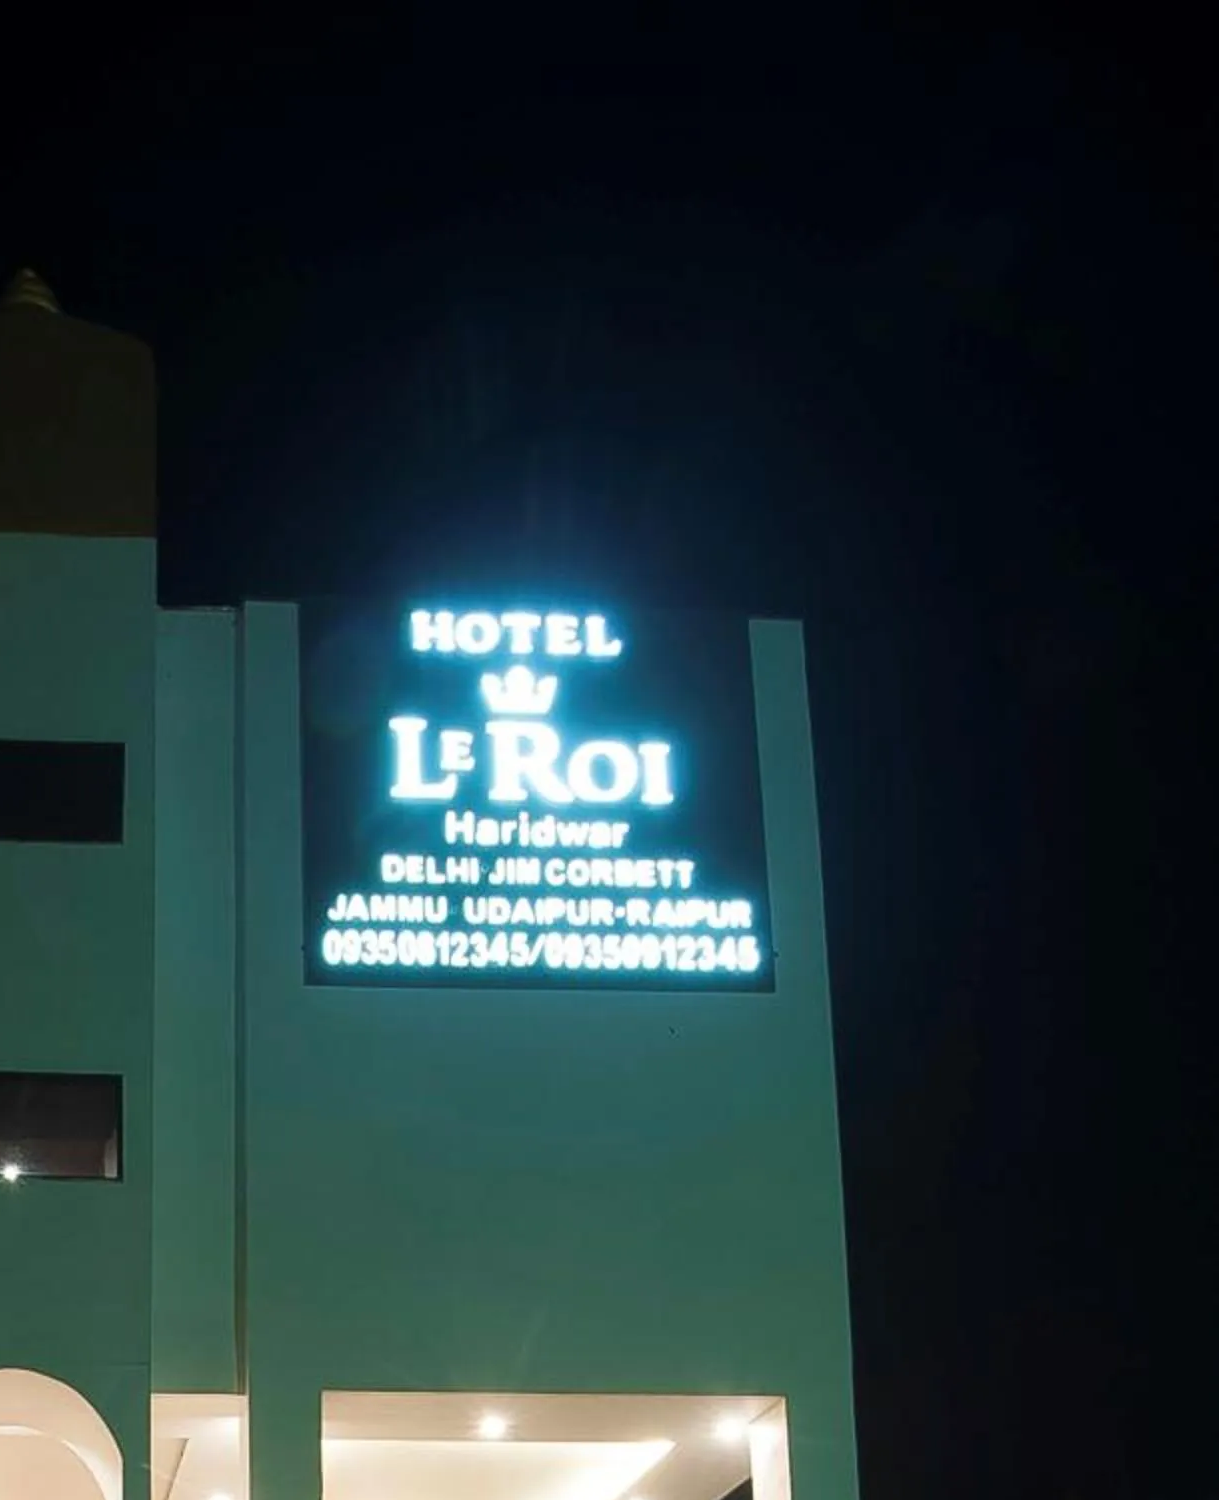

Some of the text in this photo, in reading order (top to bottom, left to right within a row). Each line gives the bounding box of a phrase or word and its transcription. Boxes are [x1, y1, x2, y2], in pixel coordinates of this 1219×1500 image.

[409, 610, 623, 657] HOTEL
[444, 811, 630, 849] Haridwar
[380, 854, 480, 885] DELHI
[327, 894, 448, 924] JAMMU
